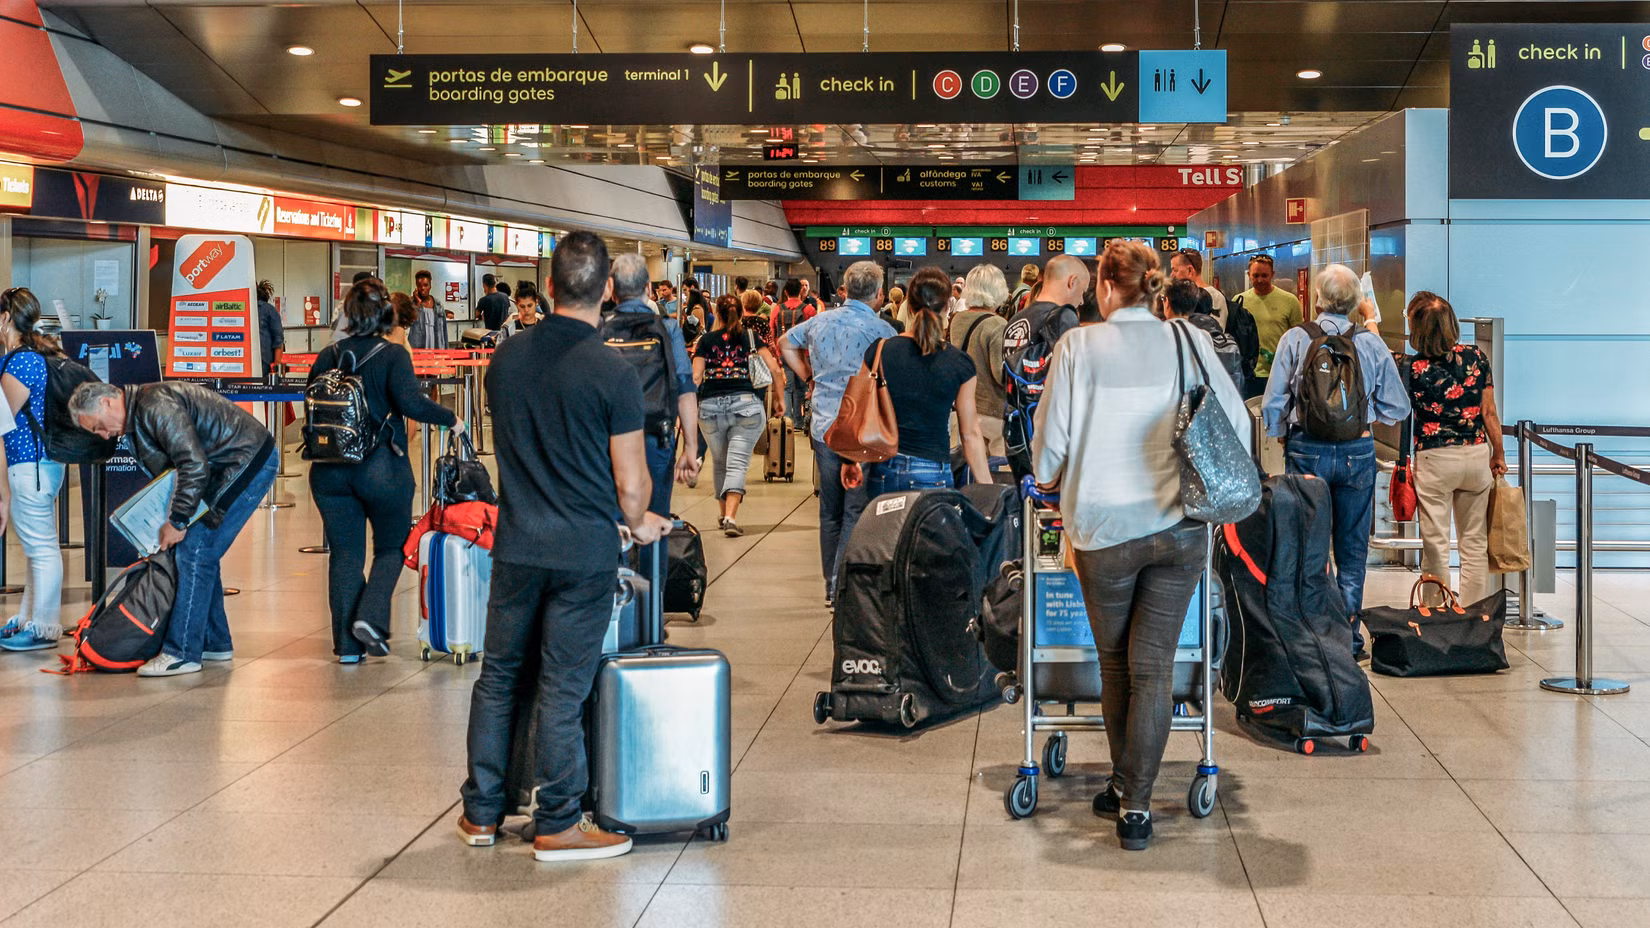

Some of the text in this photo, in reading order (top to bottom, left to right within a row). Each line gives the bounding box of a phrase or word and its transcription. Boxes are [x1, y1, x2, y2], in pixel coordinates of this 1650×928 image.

[1518, 43, 1601, 60] check in
[429, 67, 608, 86] portas de embarque
[624, 68, 690, 82] terminal 1
[820, 76, 894, 92] check in
[941, 77, 954, 93] C
[980, 77, 992, 93] D
[1019, 77, 1029, 93] E
[1057, 77, 1067, 92] F
[429, 86, 555, 104] boarding gates
[1544, 107, 1580, 158] B
[748, 171, 841, 181] portas de embarque
[919, 168, 967, 180] alfândega
[1177, 168, 1222, 185] Tell
[748, 180, 814, 190] boarding gates
[919, 179, 957, 188] customs
[136, 187, 158, 202] DELTA
[276, 206, 310, 227] Reservations
[311, 211, 320, 228] and
[320, 211, 343, 233] Ticketing
[819, 239, 836, 252] 89
[876, 239, 893, 252] 88
[991, 239, 1008, 251] 86
[1047, 239, 1064, 252] 85
[1160, 239, 1178, 252] 83
[185, 244, 223, 285] portway
[213, 348, 241, 357] orbest!
[1046, 591, 1054, 599] In
[1046, 600, 1085, 608] with Lisbo
[1046, 609, 1087, 619] for 75 year
[842, 659, 880, 674] evoc
